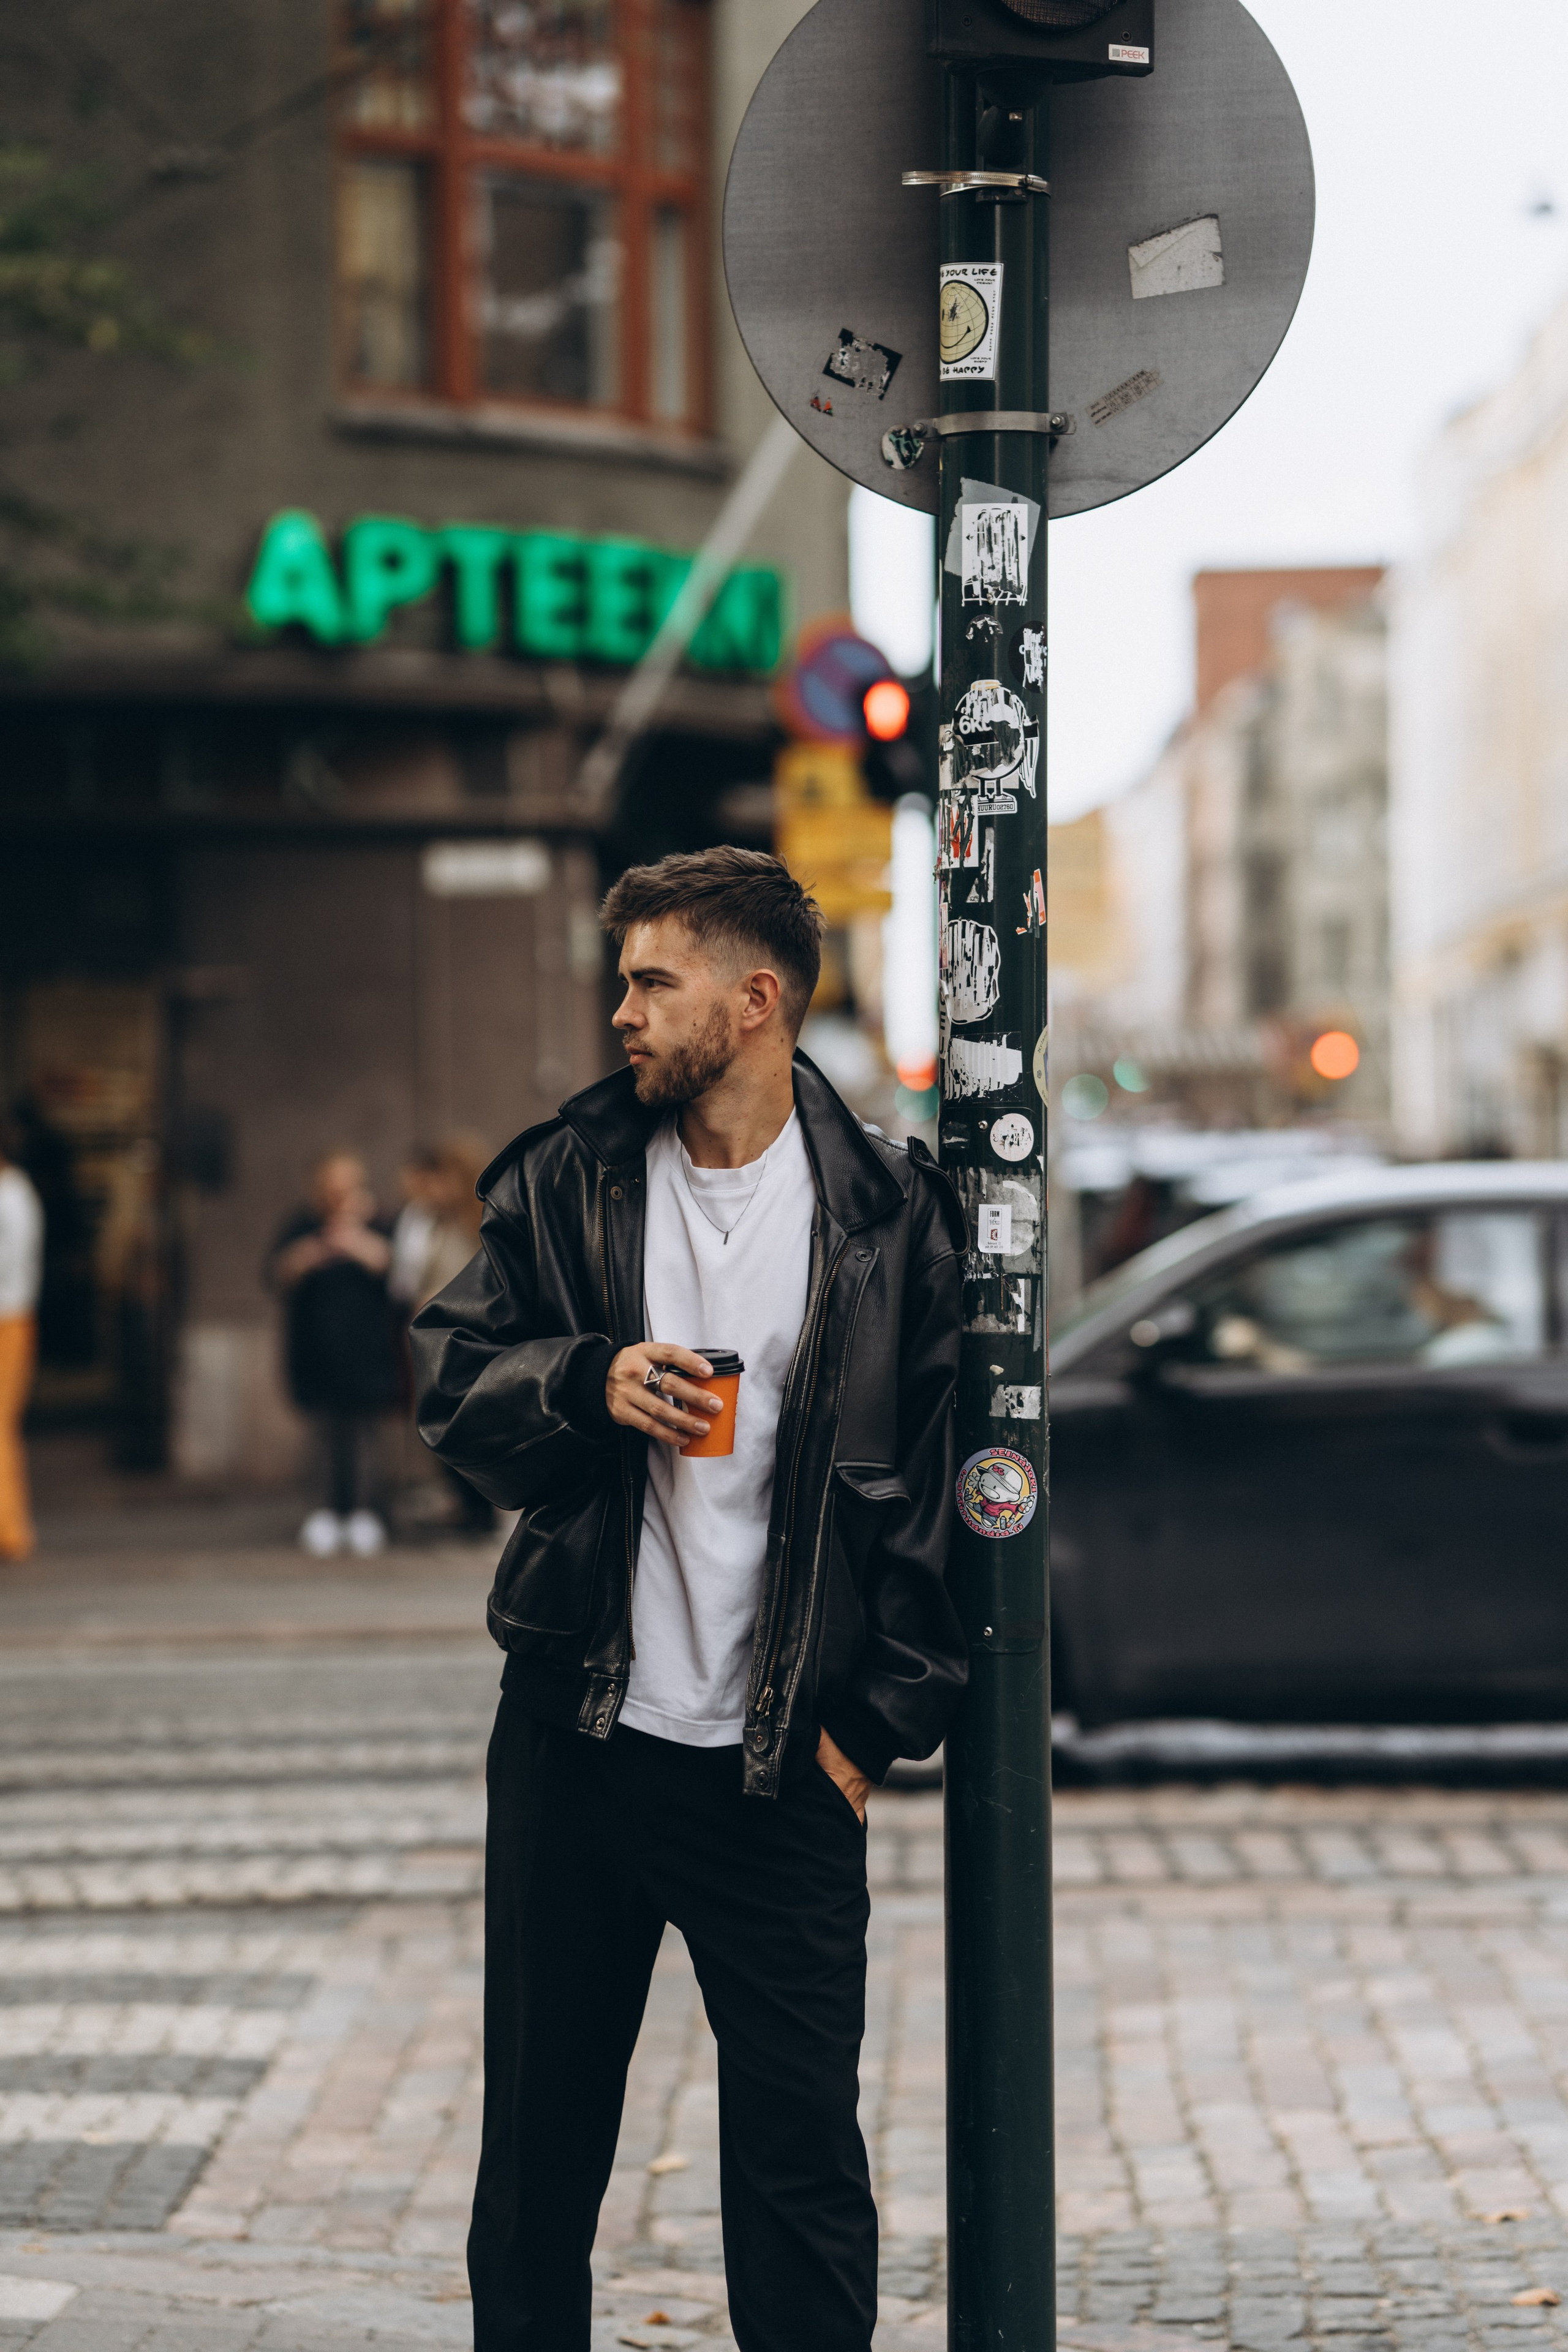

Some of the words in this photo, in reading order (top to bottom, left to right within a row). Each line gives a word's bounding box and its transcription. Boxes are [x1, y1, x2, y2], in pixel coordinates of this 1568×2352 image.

[1121, 49, 1145, 59] PEEK
[946, 268, 968, 277] YOUR
[971, 268, 997, 276] LIFE
